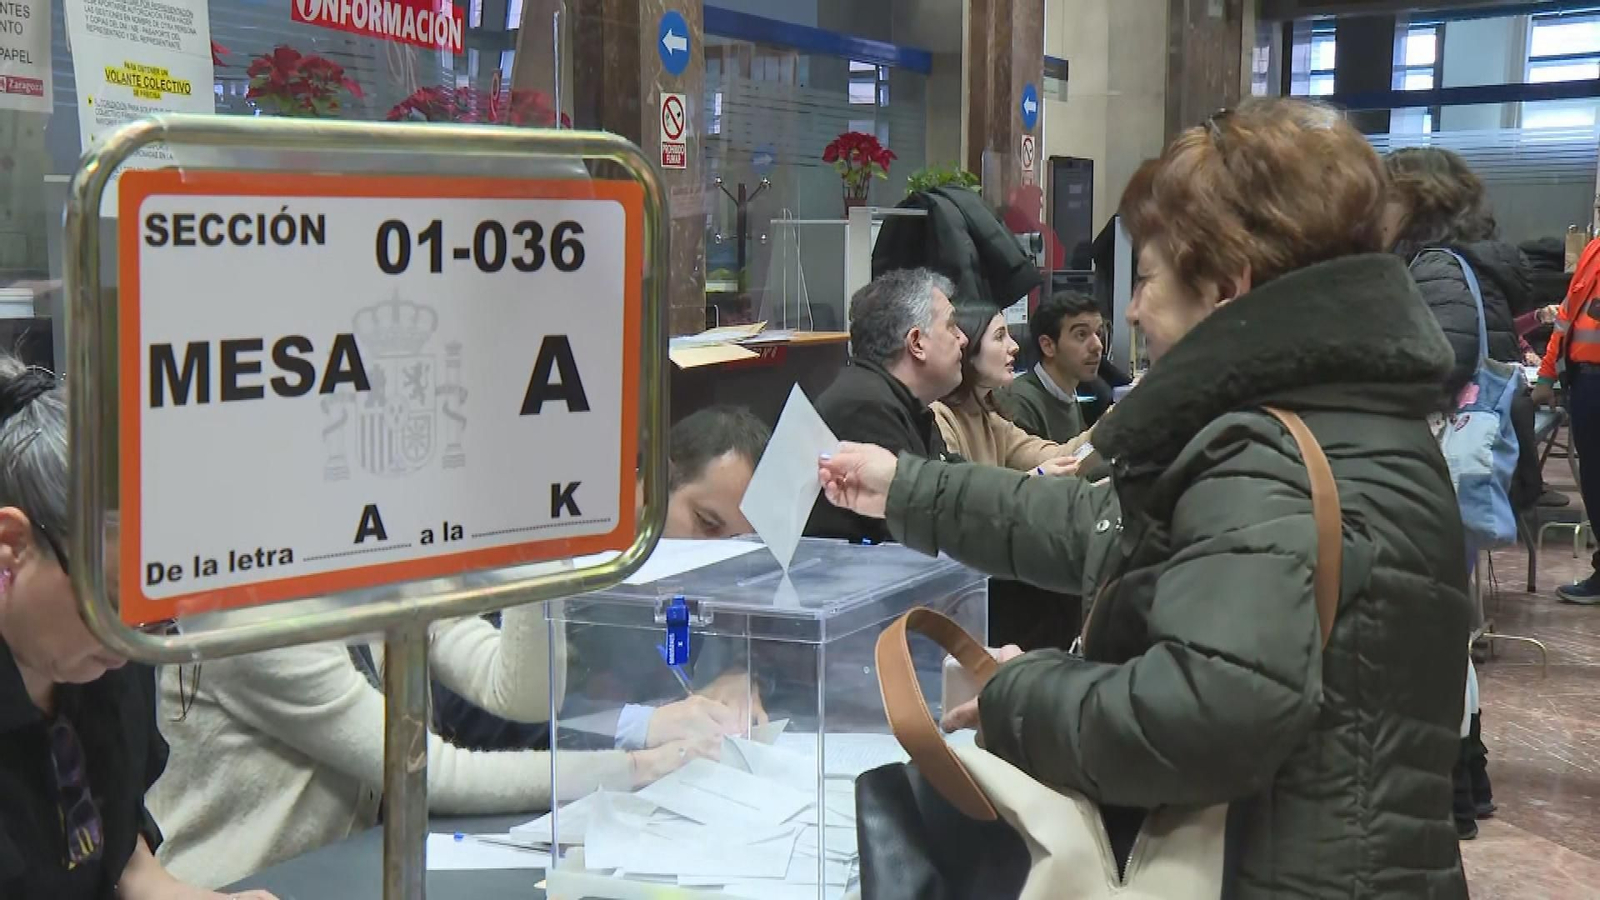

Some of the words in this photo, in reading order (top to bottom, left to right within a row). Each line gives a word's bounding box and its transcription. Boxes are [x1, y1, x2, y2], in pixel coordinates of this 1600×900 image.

[8, 78, 43, 94] Zaragoza
[105, 67, 141, 86] VOLANTE
[143, 76, 192, 95] COLECTIVO
[144, 205, 326, 247] SECCIÓN
[375, 219, 586, 275] 01-036
[149, 332, 372, 409] MESA
[520, 334, 591, 416] A
[147, 562, 183, 586] De
[194, 555, 218, 579] la
[229, 548, 294, 574] letra
[354, 504, 388, 544] A
[420, 529, 434, 546] a
[443, 521, 464, 543] la
[550, 481, 582, 519] K
